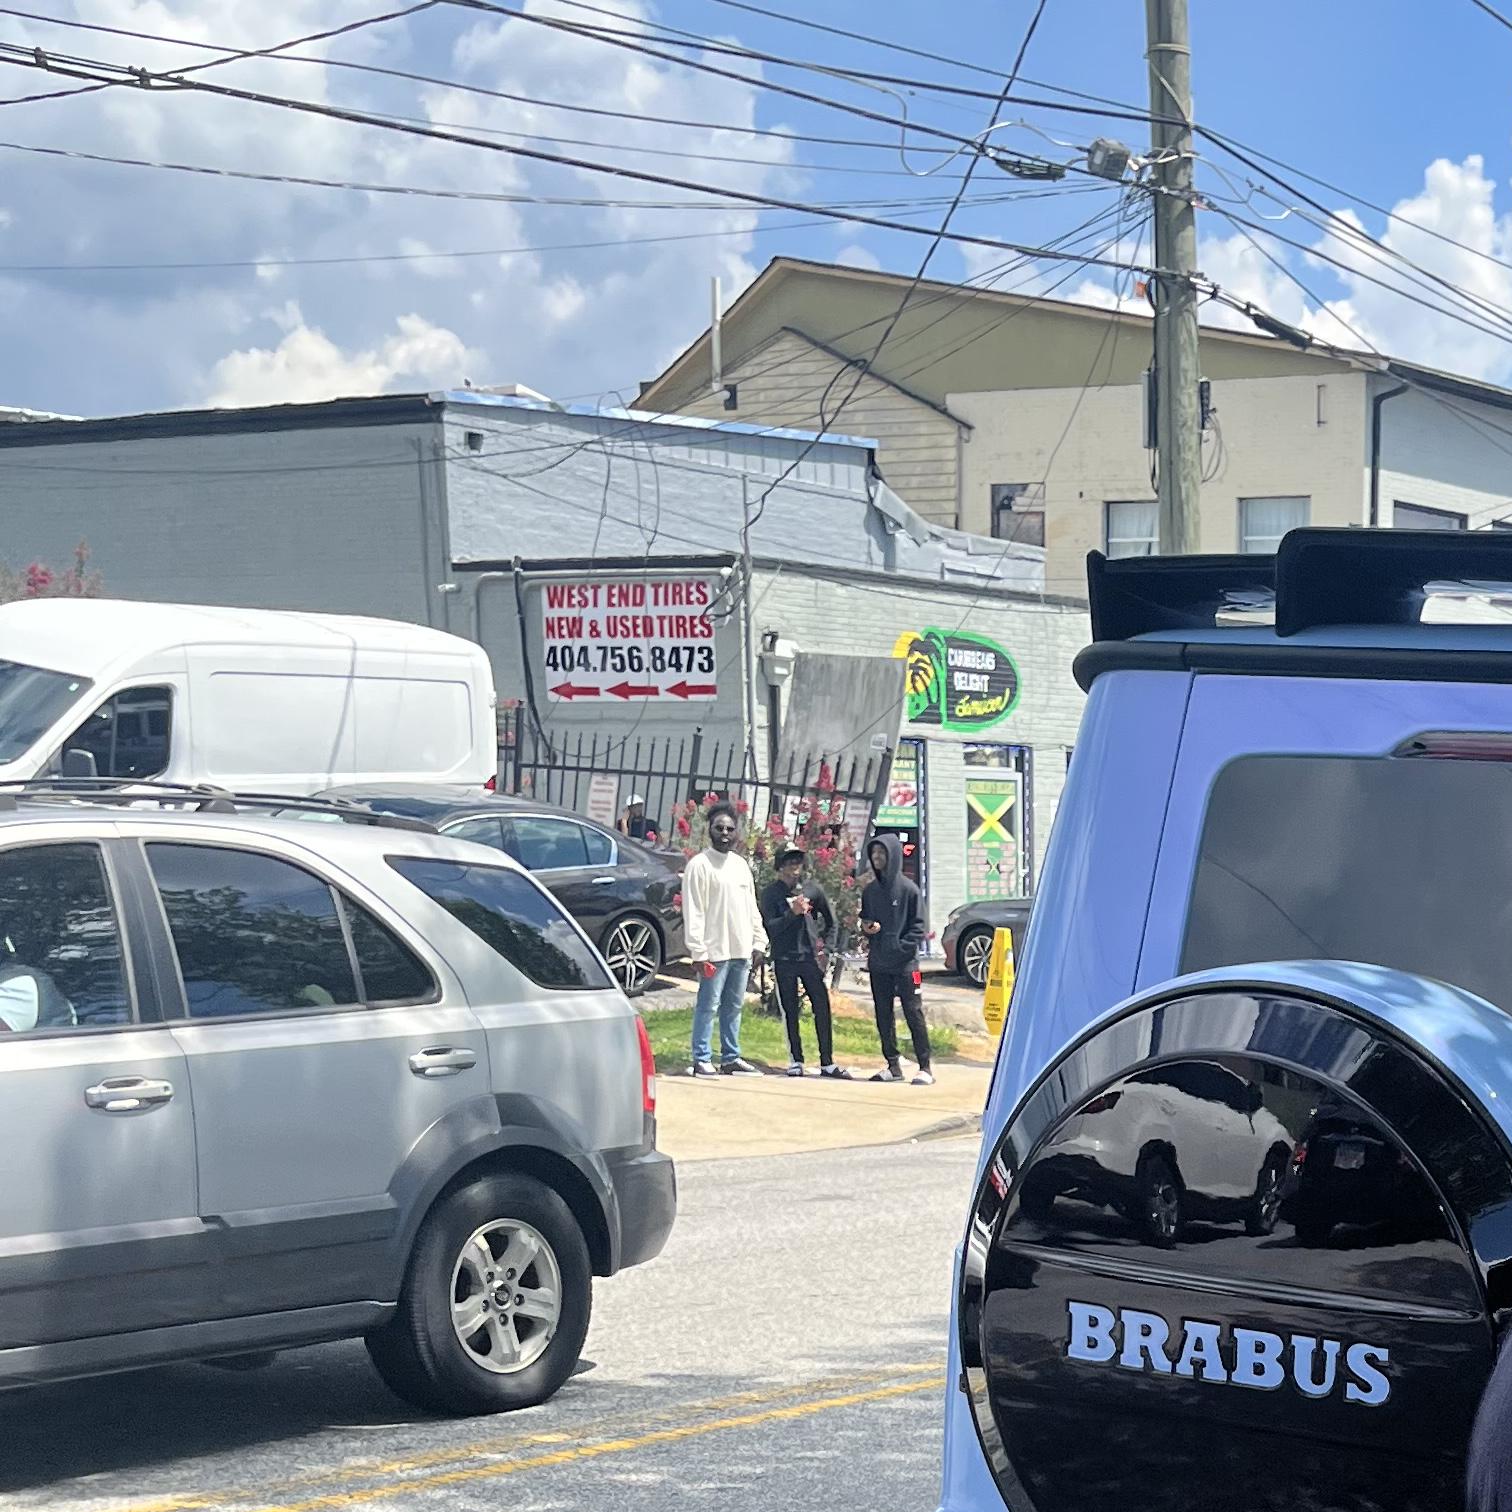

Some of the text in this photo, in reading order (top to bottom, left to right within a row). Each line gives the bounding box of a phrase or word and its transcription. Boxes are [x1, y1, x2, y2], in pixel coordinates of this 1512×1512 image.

[547, 581, 709, 608] WEST END TIRES
[545, 614, 713, 639] NEW & USED TIRES
[545, 645, 714, 674] 404.756.8473
[1066, 1300, 1392, 1406] BRABUS
